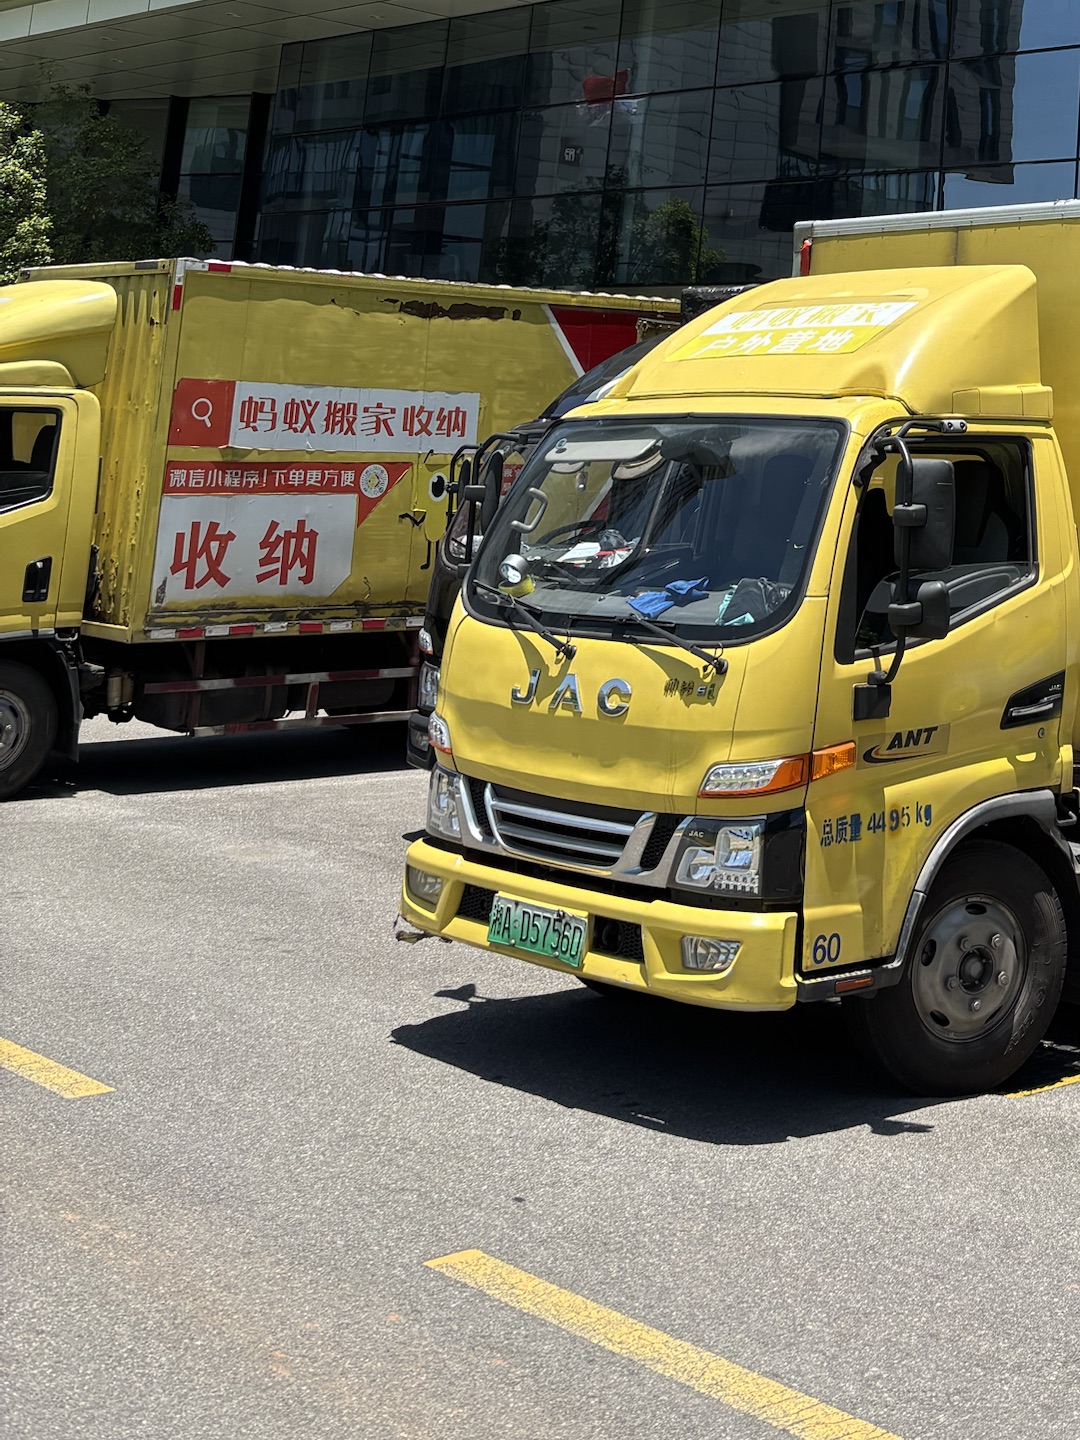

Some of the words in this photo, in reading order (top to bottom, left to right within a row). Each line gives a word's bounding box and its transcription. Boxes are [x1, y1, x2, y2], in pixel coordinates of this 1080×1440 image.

[690, 328, 855, 358] 户外营地
[238, 395, 468, 438] 蚂蚁搬家收纳
[170, 519, 319, 590] 收纳
[511, 668, 633, 717] JAC
[886, 726, 938, 751] ANT
[820, 813, 862, 847] 总质量
[867, 806, 910, 833] 4495
[916, 801, 932, 827] kg
[813, 932, 841, 965] 60
